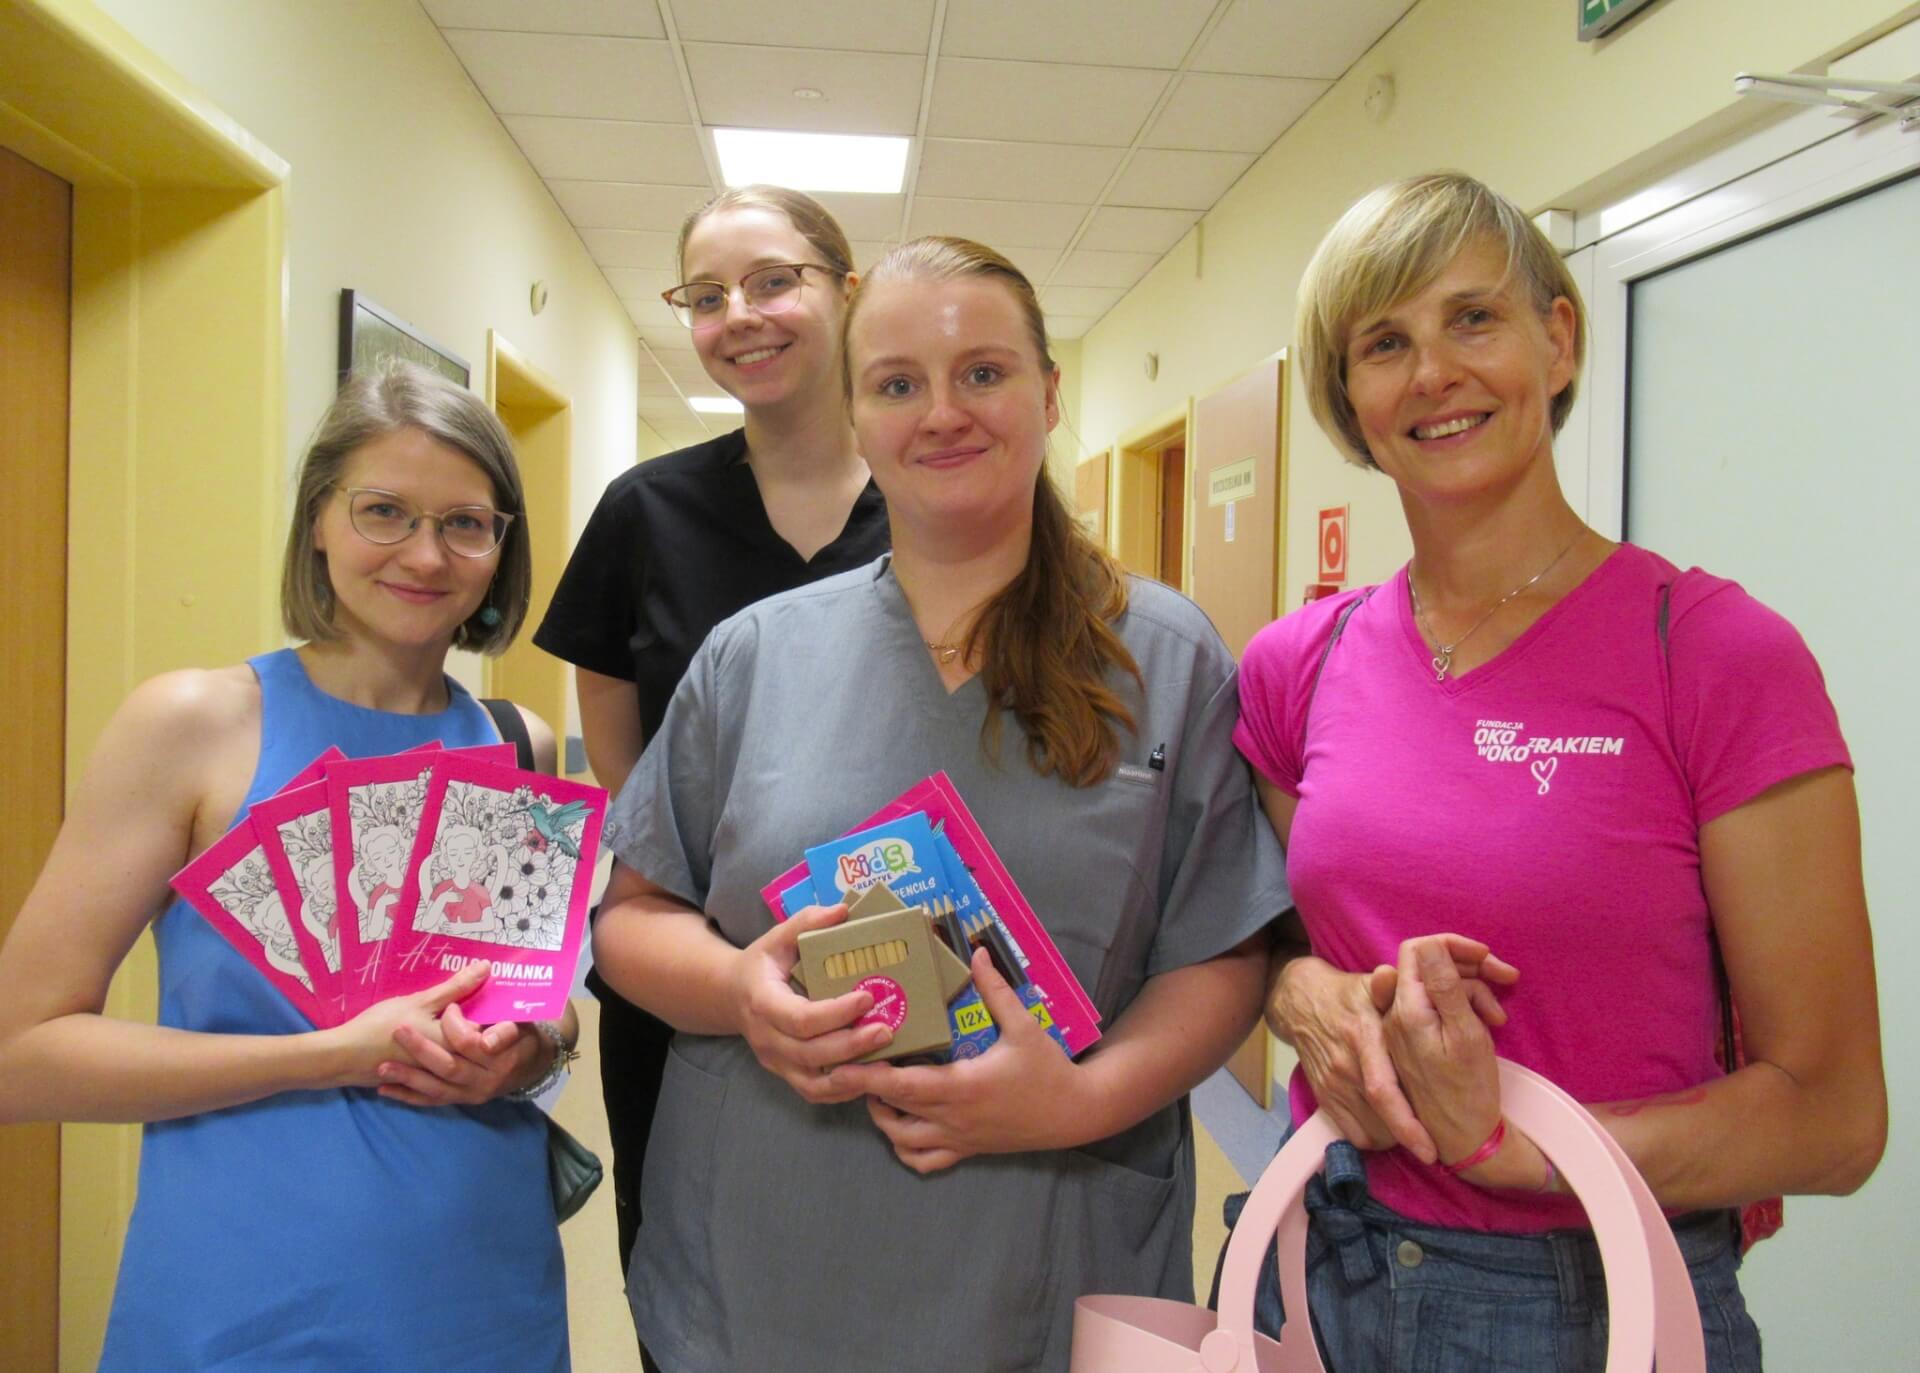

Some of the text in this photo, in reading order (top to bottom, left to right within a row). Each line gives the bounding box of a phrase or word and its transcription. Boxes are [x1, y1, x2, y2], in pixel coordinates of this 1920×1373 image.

[1476, 720, 1524, 730] FUNDACJA
[1474, 728, 1517, 745] OKO
[840, 844, 908, 884] kids
[961, 1009, 987, 1029] 12X
